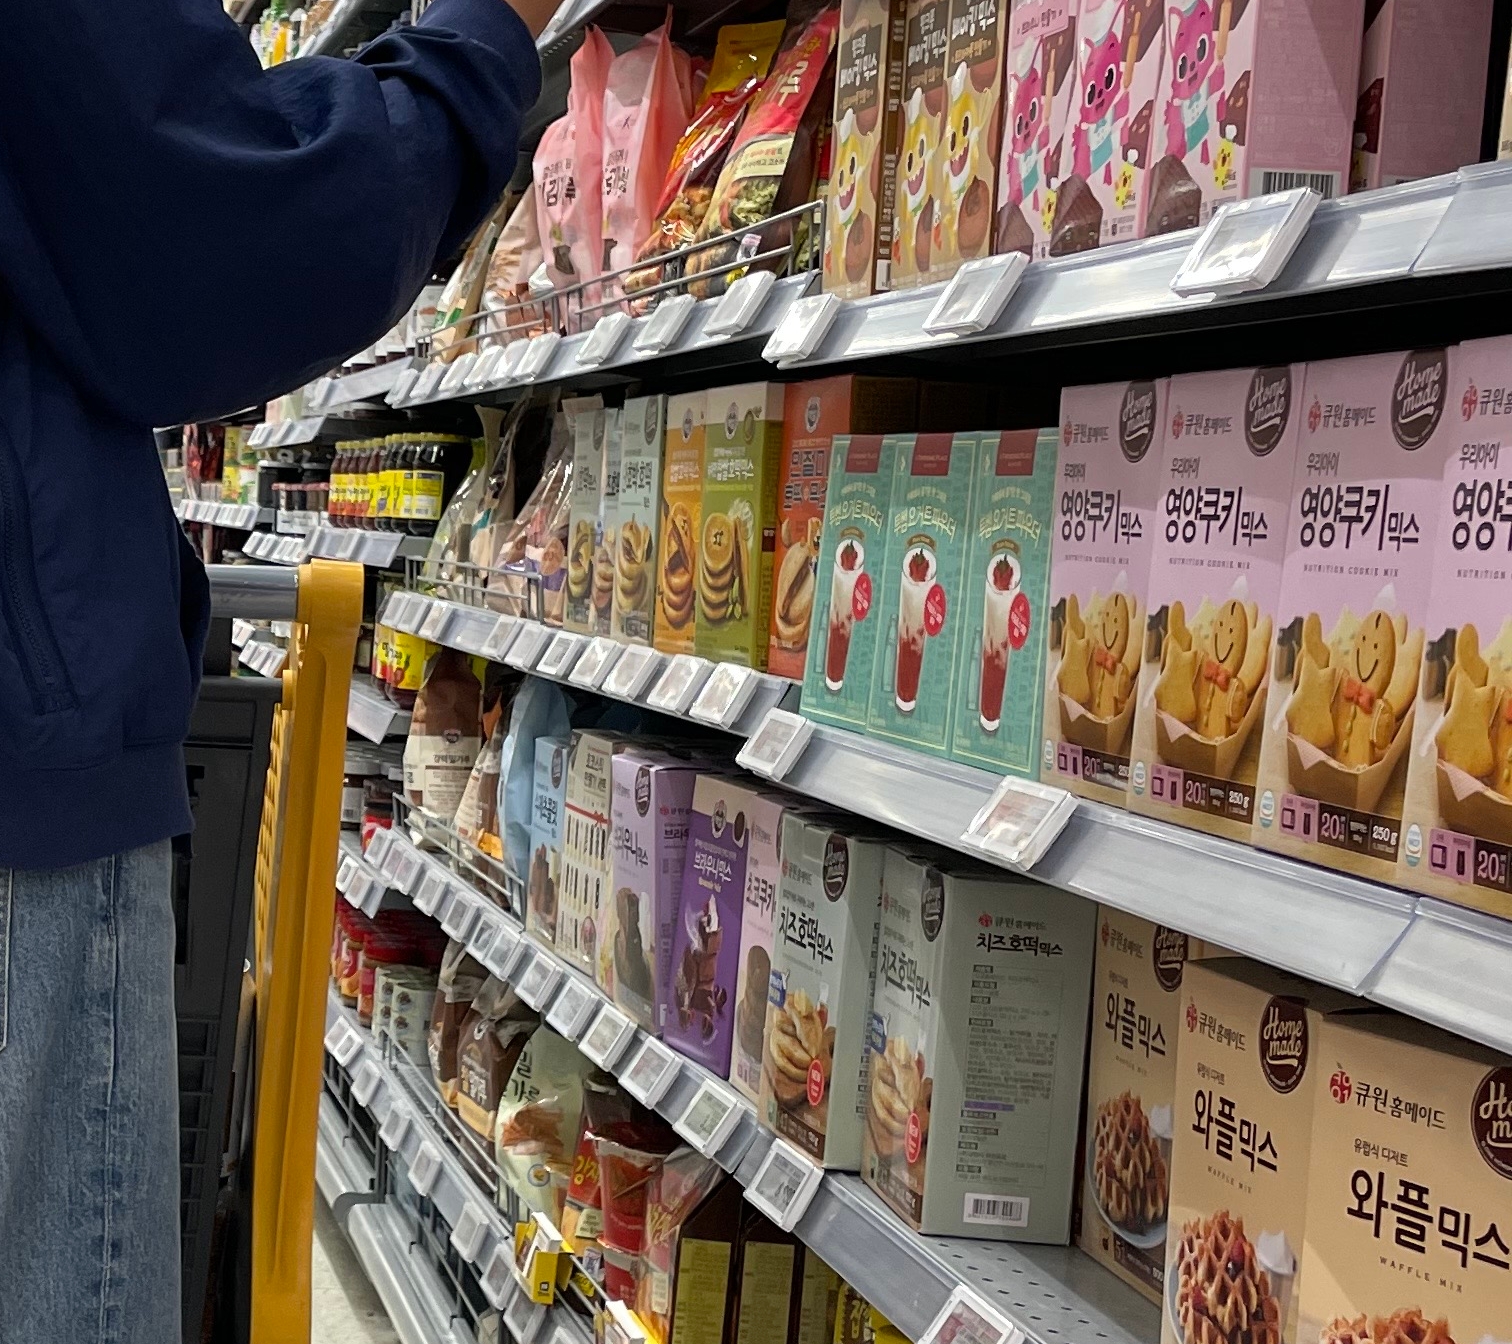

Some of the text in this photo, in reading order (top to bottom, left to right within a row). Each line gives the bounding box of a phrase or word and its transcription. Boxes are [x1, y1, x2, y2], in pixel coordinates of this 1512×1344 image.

[1397, 361, 1441, 400] Home
[1401, 383, 1440, 417] made
[1459, 441, 1501, 471] 우리아이
[1198, 1010, 1218, 1039] 큐원
[1263, 1005, 1305, 1040] Home
[1267, 1036, 1303, 1059] made
[1354, 1081, 1448, 1131] 큐원 홈메이드
[1353, 1137, 1410, 1169] 유럽식 디저트
[1379, 1255, 1465, 1295] WAFFLE MIX
